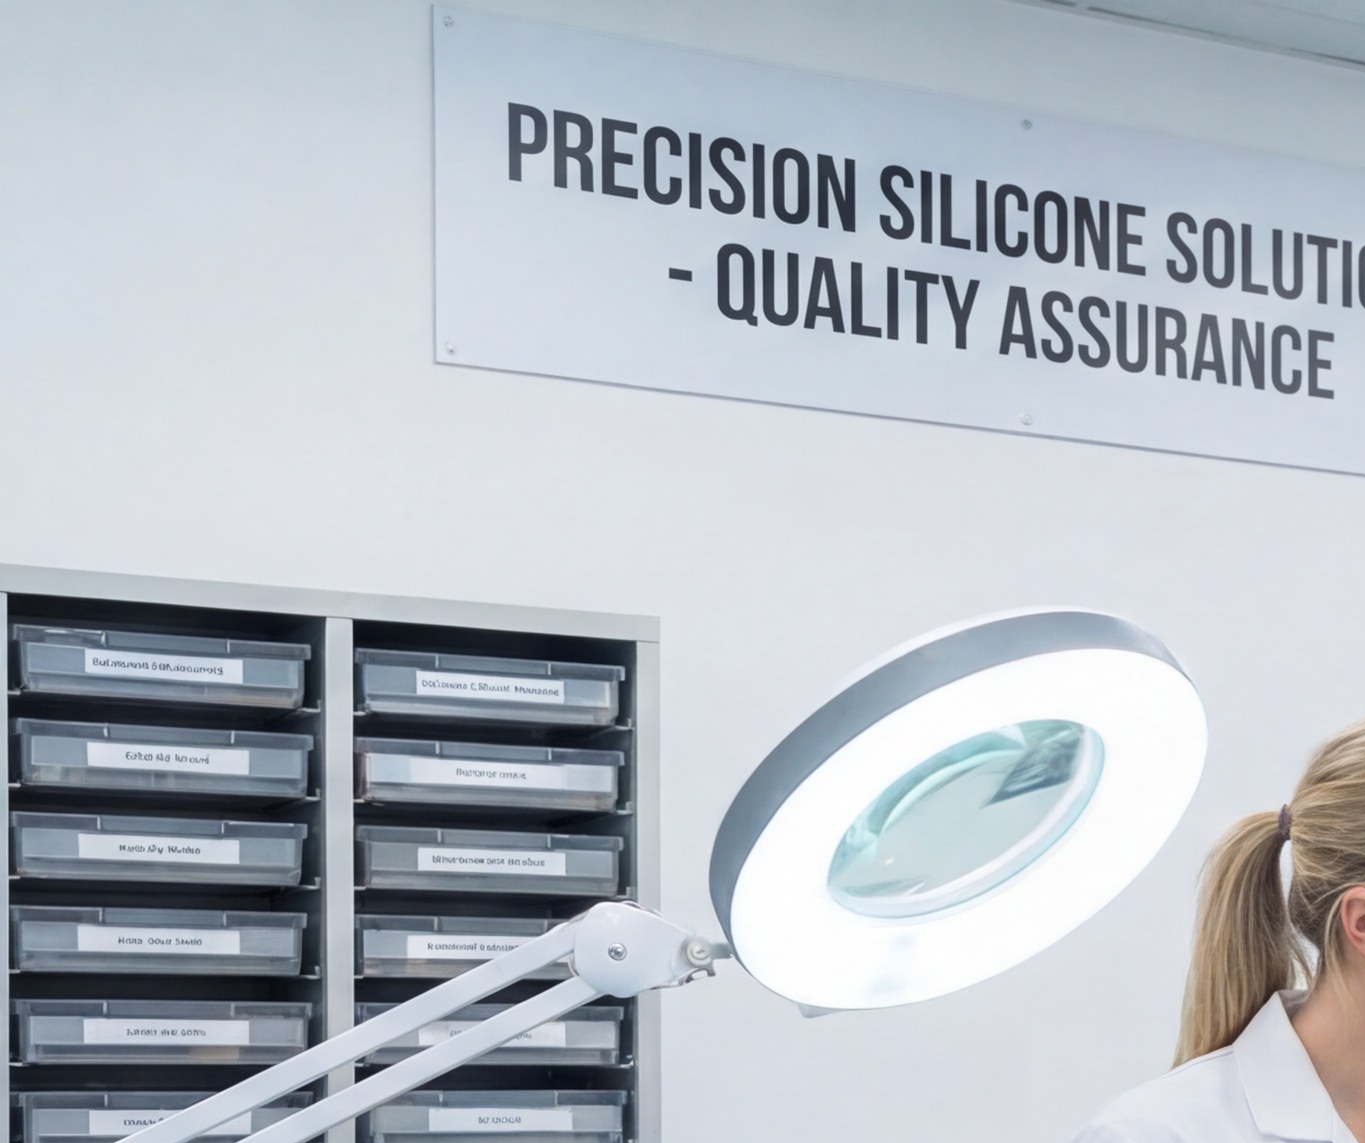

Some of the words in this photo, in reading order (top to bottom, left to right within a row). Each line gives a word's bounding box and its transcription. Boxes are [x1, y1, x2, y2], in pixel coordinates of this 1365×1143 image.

[507, 102, 856, 233] PRECISION
[879, 164, 1147, 277] SILICONE
[668, 267, 693, 282] -
[716, 242, 981, 350] QUALITY
[998, 285, 1335, 400] ASSURANCE
